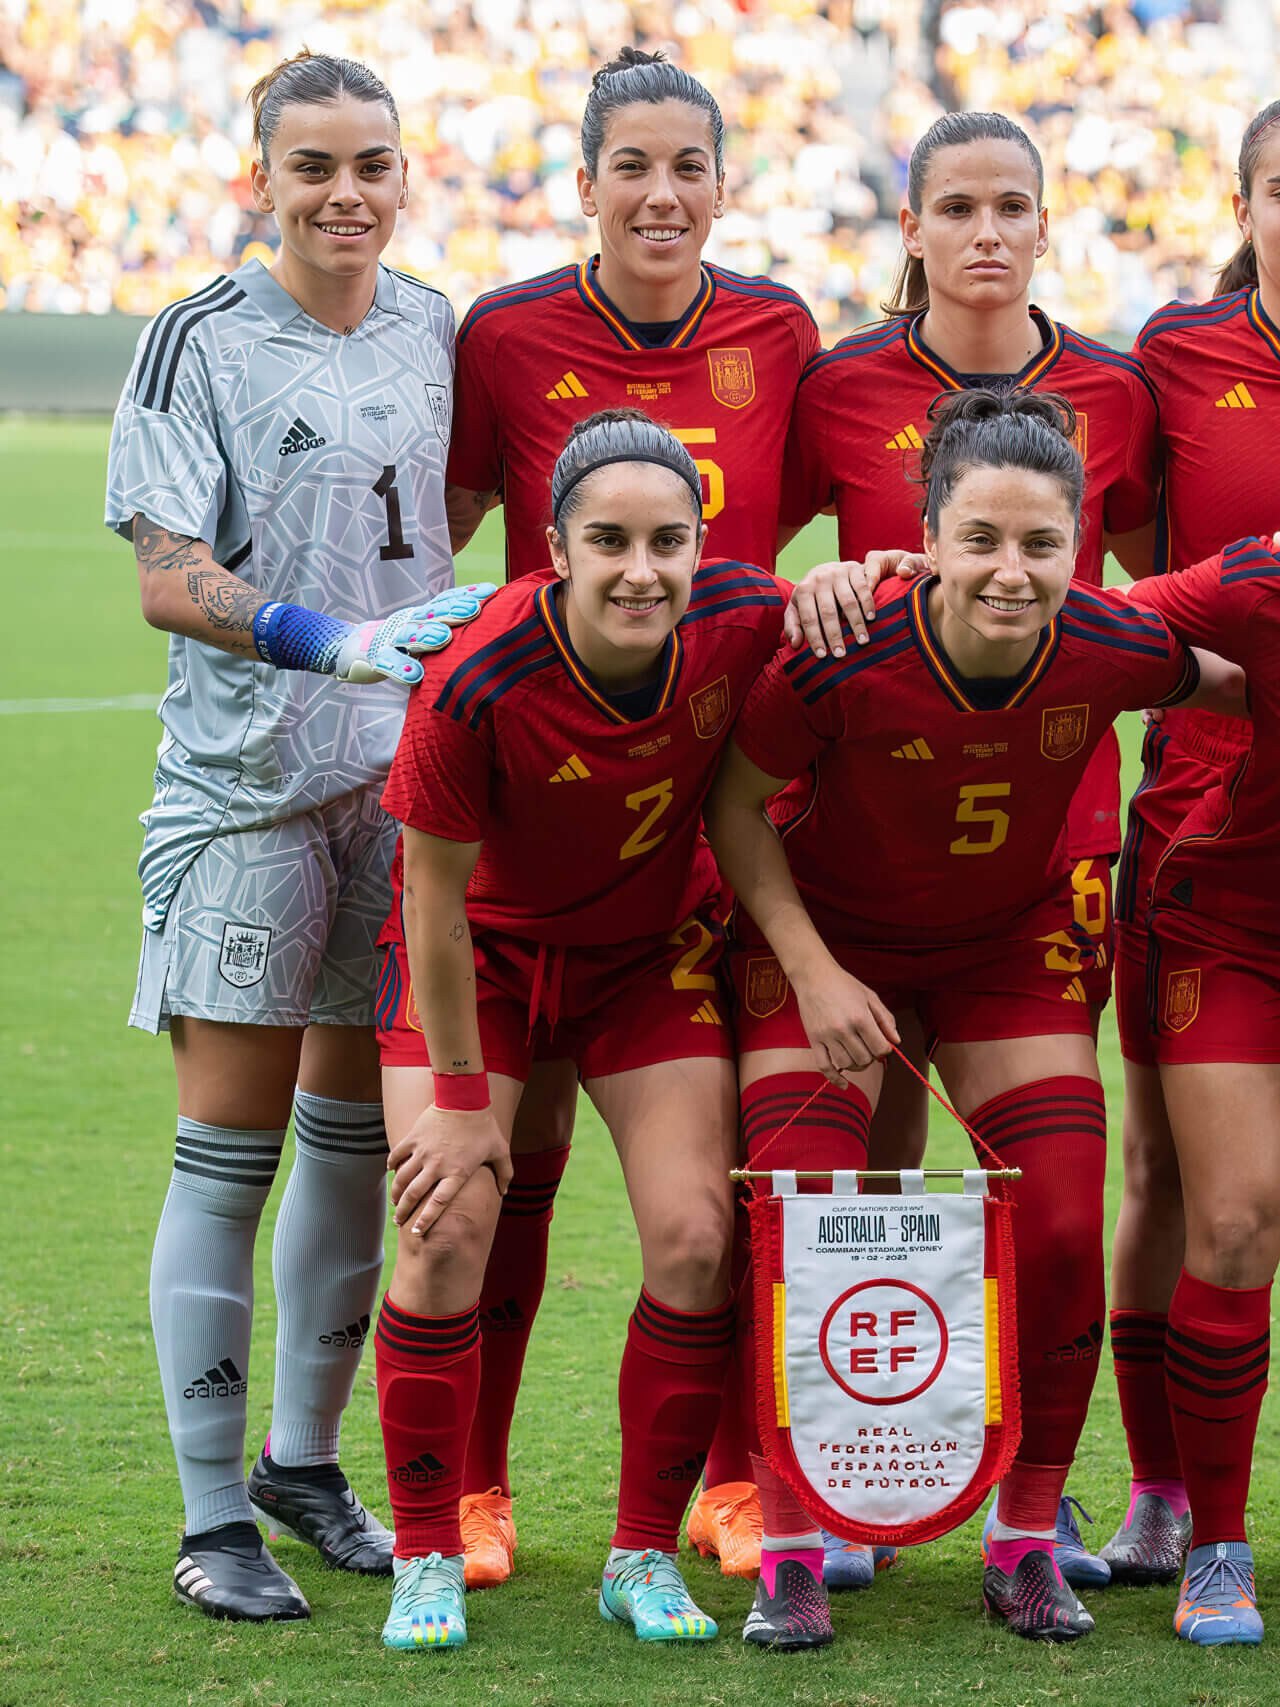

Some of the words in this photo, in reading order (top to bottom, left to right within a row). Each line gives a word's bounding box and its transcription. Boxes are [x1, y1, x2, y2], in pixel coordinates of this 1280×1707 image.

[279, 436, 326, 456] adidas
[372, 465, 415, 560] 1
[619, 777, 673, 860] 2
[950, 782, 1011, 855] 5
[1071, 859, 1106, 935] 6
[669, 918, 717, 992] 2
[818, 1215, 886, 1243] AUSTRALIA
[900, 1213, 940, 1242] SPAIN
[184, 1381, 247, 1399] adidas
[858, 1427, 912, 1437] REAL
[819, 1440, 957, 1454] FEDERACIÓN
[831, 1459, 945, 1471] ESPAÑOLA
[828, 1479, 851, 1488] DE
[865, 1476, 950, 1489] FÚTBOL
